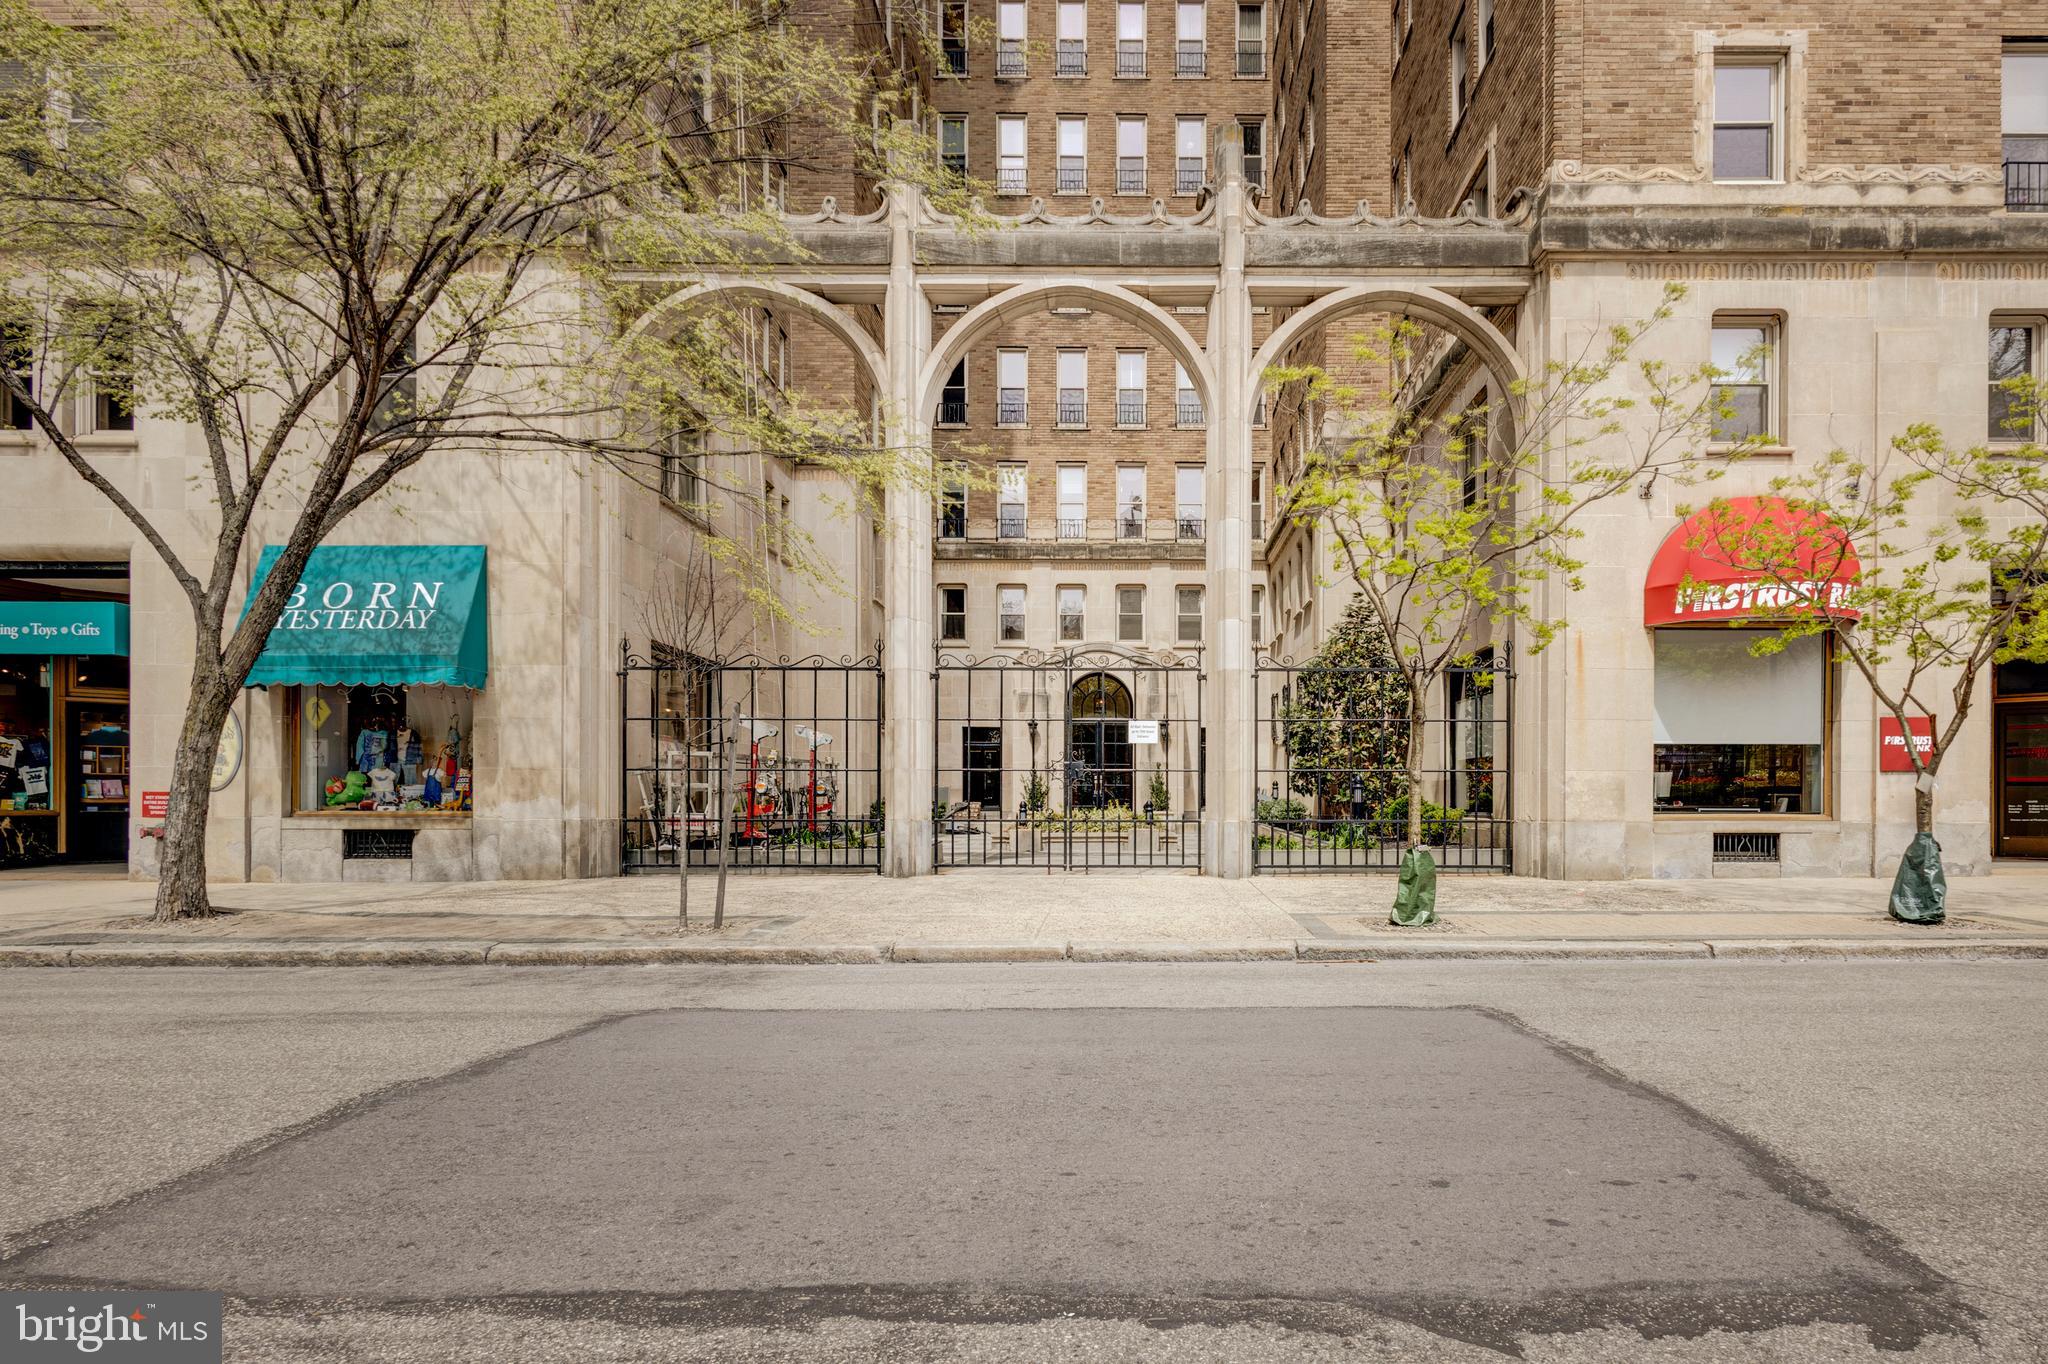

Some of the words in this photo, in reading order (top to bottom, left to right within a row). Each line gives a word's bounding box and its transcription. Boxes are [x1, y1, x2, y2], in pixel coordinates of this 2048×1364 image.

[285, 582, 444, 609] BORN
[274, 609, 437, 630] YESTERDAY
[30, 622, 58, 639] Toys
[71, 622, 101, 636] Gifts
[1884, 735, 1932, 745] FIRSRUST
[1904, 744, 1931, 752] NK
